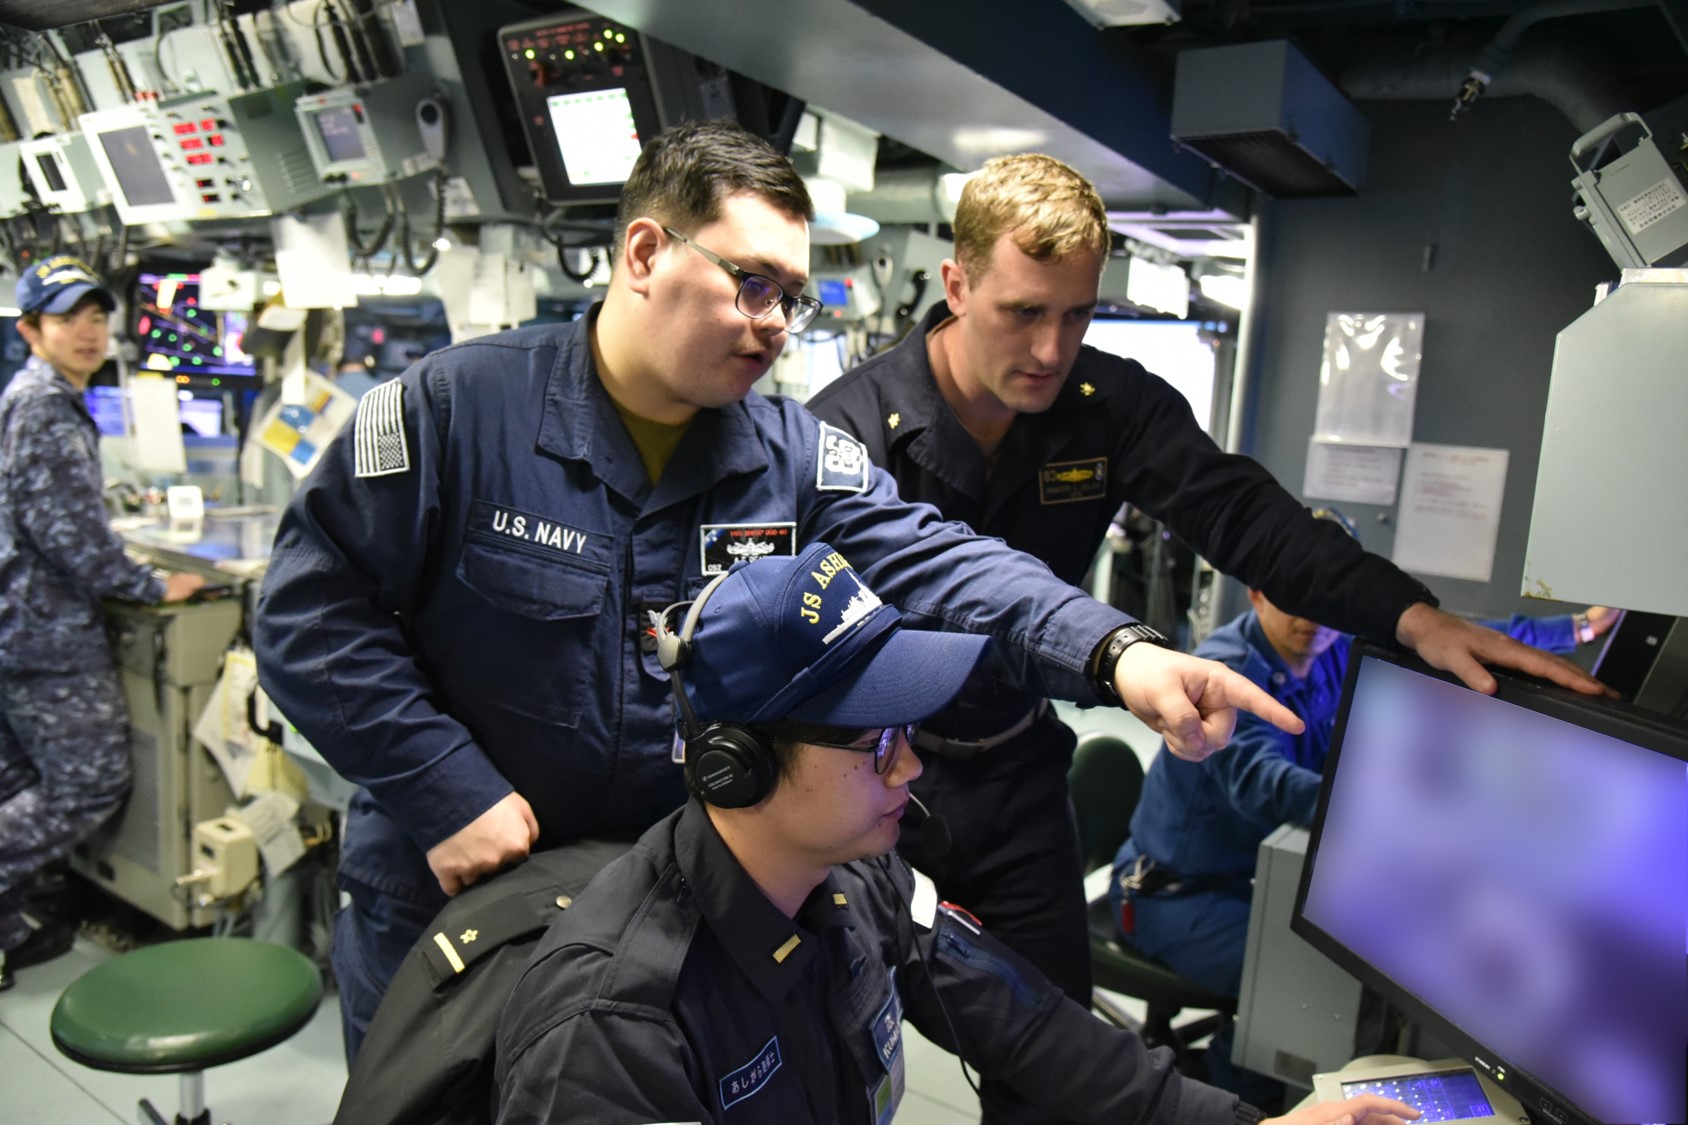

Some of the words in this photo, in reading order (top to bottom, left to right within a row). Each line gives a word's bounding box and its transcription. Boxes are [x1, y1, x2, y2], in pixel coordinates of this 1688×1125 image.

[492, 510, 530, 540] U.S.
[534, 521, 587, 554] NAVY
[811, 551, 854, 590] ASHI
[800, 591, 823, 625] JS
